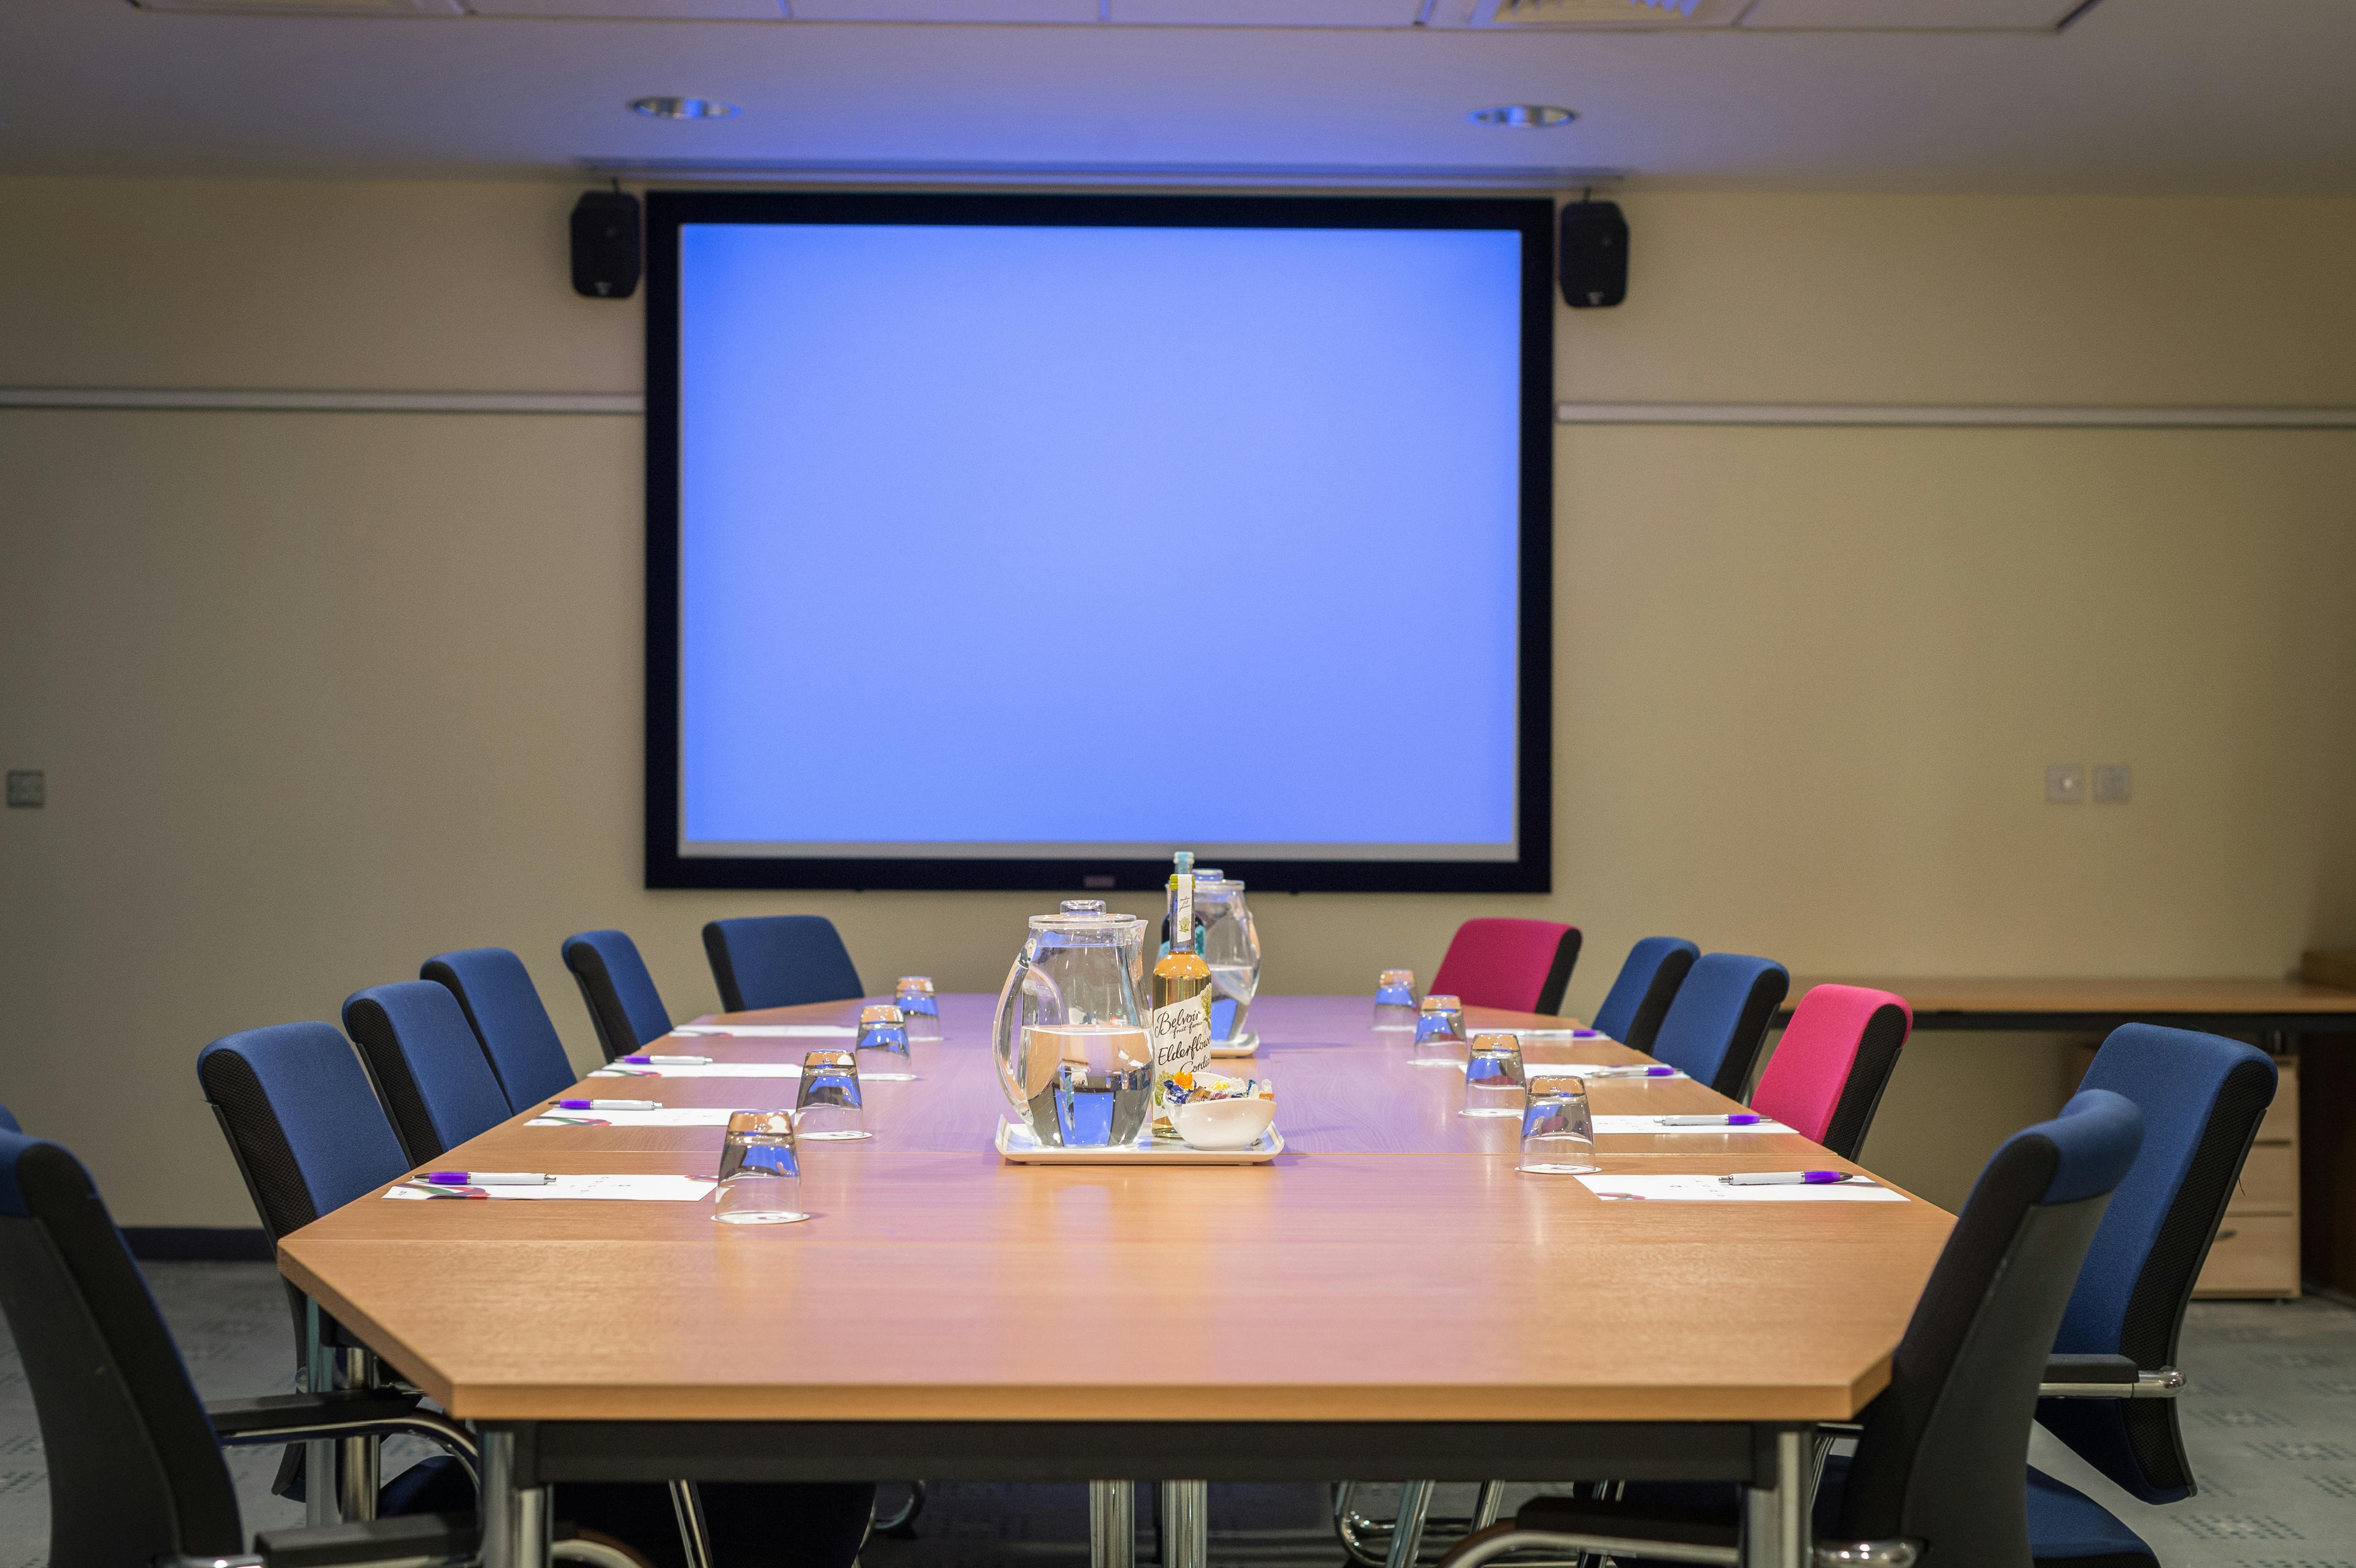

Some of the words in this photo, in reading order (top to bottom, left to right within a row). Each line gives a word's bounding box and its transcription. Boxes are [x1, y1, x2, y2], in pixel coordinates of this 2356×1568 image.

[1155, 1009, 1201, 1038] Belvoir
[1170, 1026, 1188, 1039] fruit
[1188, 1022, 1203, 1034] farms
[1158, 1033, 1211, 1066] Elderflowe
[1180, 1055, 1211, 1073] Cordia
